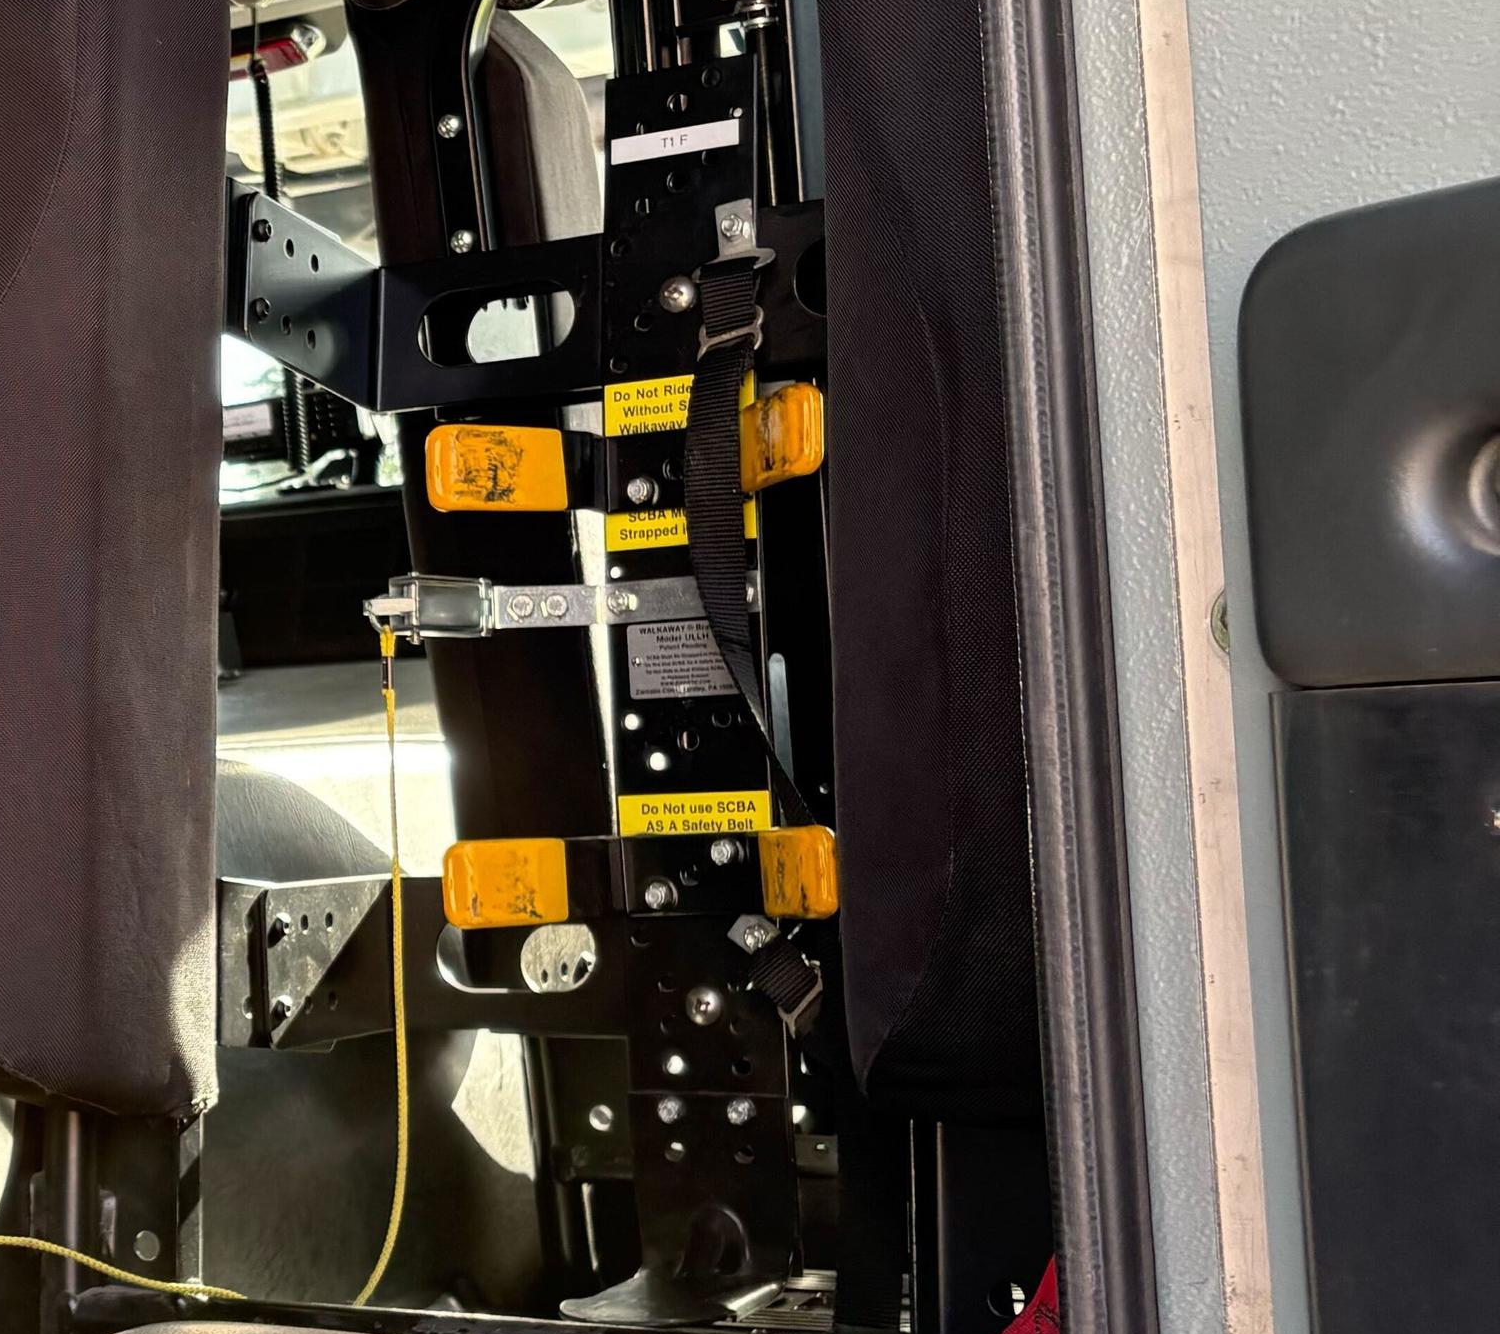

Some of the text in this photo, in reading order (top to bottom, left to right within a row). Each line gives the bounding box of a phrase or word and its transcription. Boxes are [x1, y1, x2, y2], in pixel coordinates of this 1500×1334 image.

[679, 134, 689, 146] F
[613, 384, 692, 402] Do Not Ride
[622, 402, 674, 418] Without
[618, 419, 684, 436] Walkaway
[628, 509, 667, 523] SCBA
[619, 524, 679, 542] Strapped
[656, 634, 681, 644] Model
[641, 800, 757, 815] Do Not use SCBA
[646, 818, 753, 833] AS A Safety Belt
